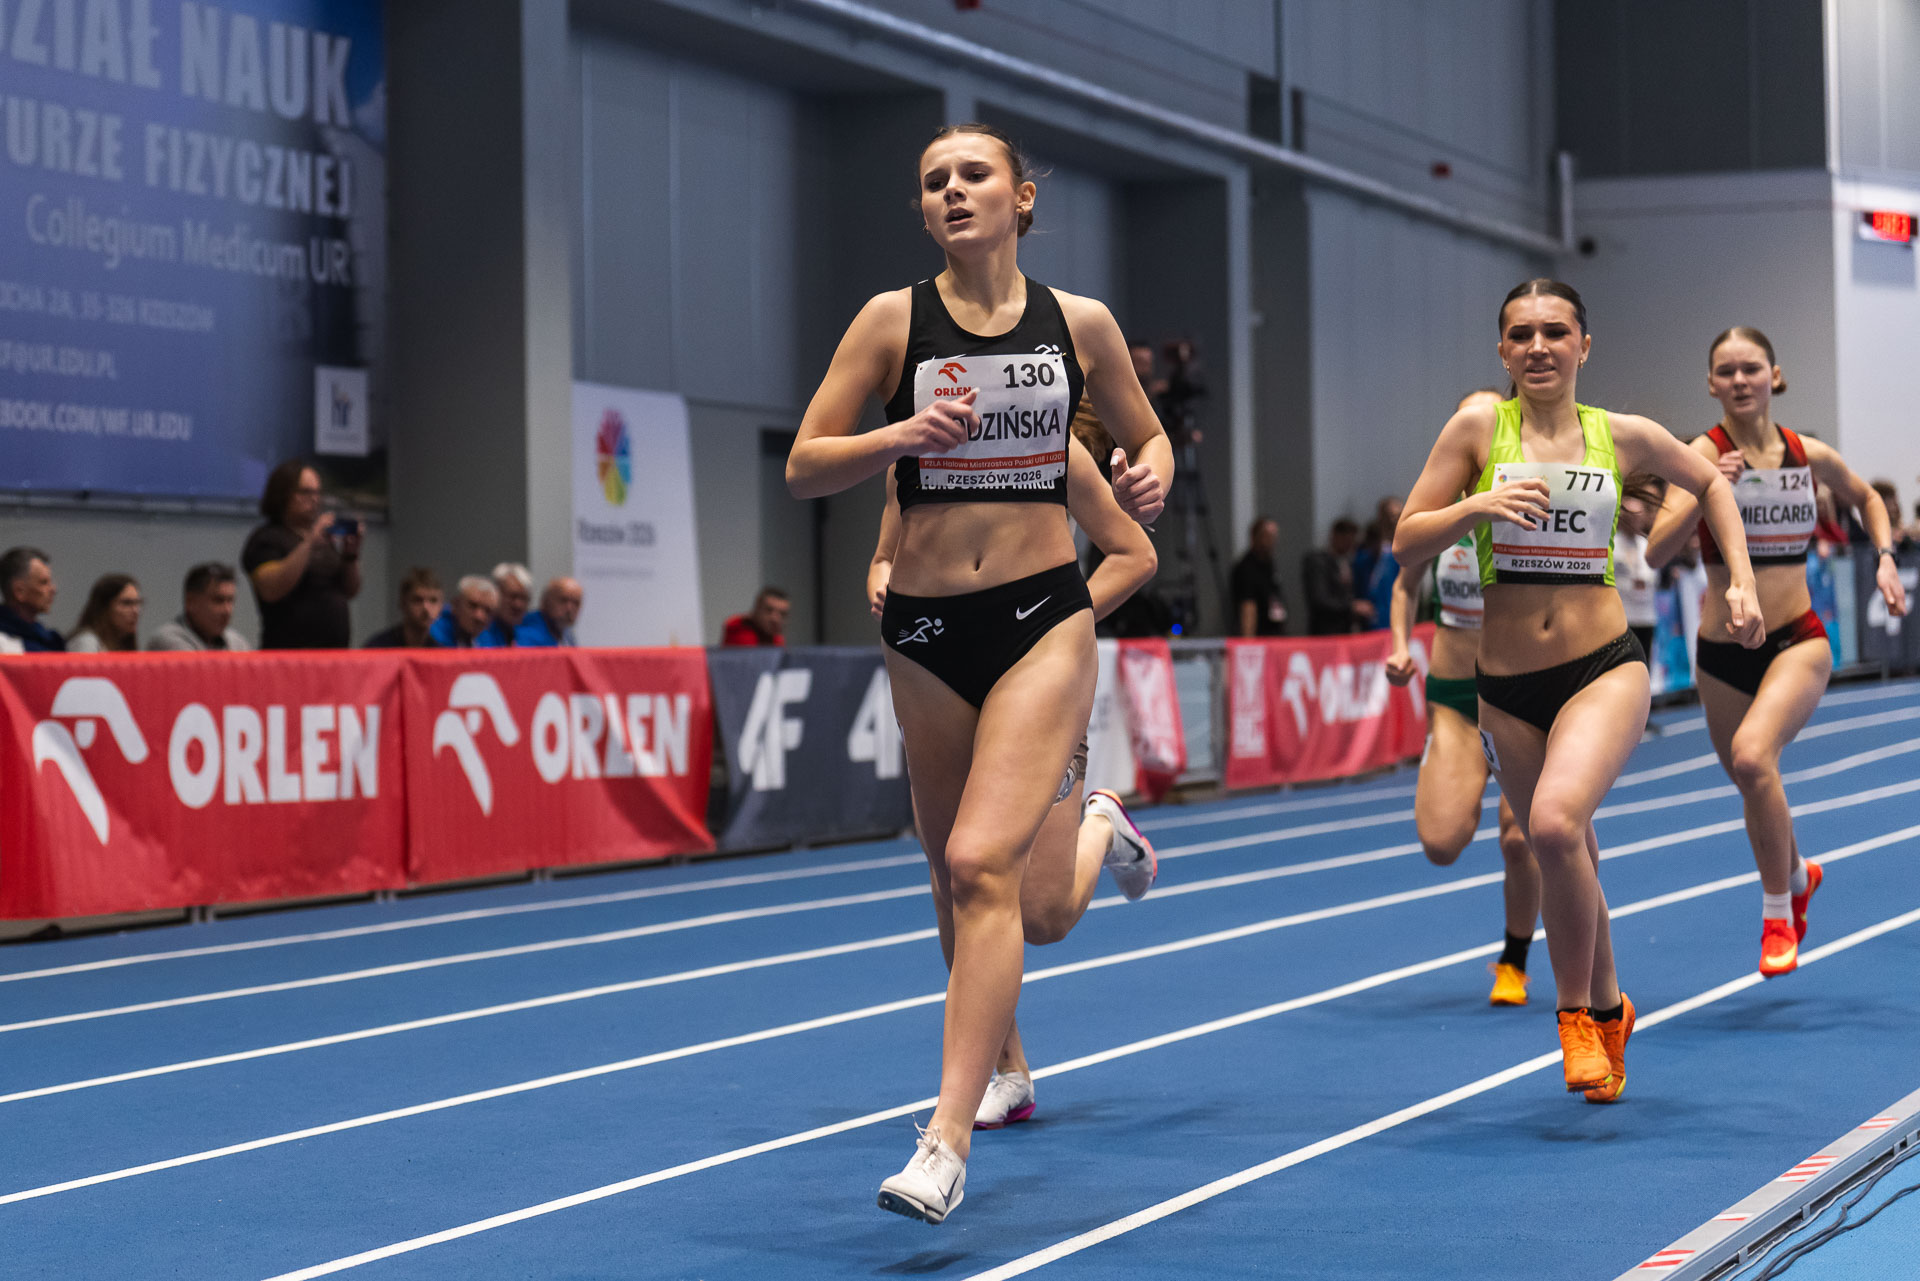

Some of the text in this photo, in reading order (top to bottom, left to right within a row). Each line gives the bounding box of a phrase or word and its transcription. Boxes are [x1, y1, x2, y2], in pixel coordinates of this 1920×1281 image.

[0, 0, 350, 128] ZIAŁ NAUK
[0, 95, 350, 219] URZE FIZYCZNEJ
[26, 194, 350, 285] Collegium Medicum UR
[934, 387, 972, 397] ORLEN
[1003, 362, 1055, 388] 130
[943, 461, 968, 469] Halowe
[970, 460, 1013, 468] Mistrzostwa
[948, 472, 1010, 485] RZESZÓW
[1014, 470, 1042, 482] 2026
[1565, 470, 1605, 492] 777
[1512, 558, 1591, 570] RZESZÓW 2026
[168, 703, 380, 808] ORLEN
[531, 692, 691, 783] ORLEN
[738, 668, 812, 791] 4F
